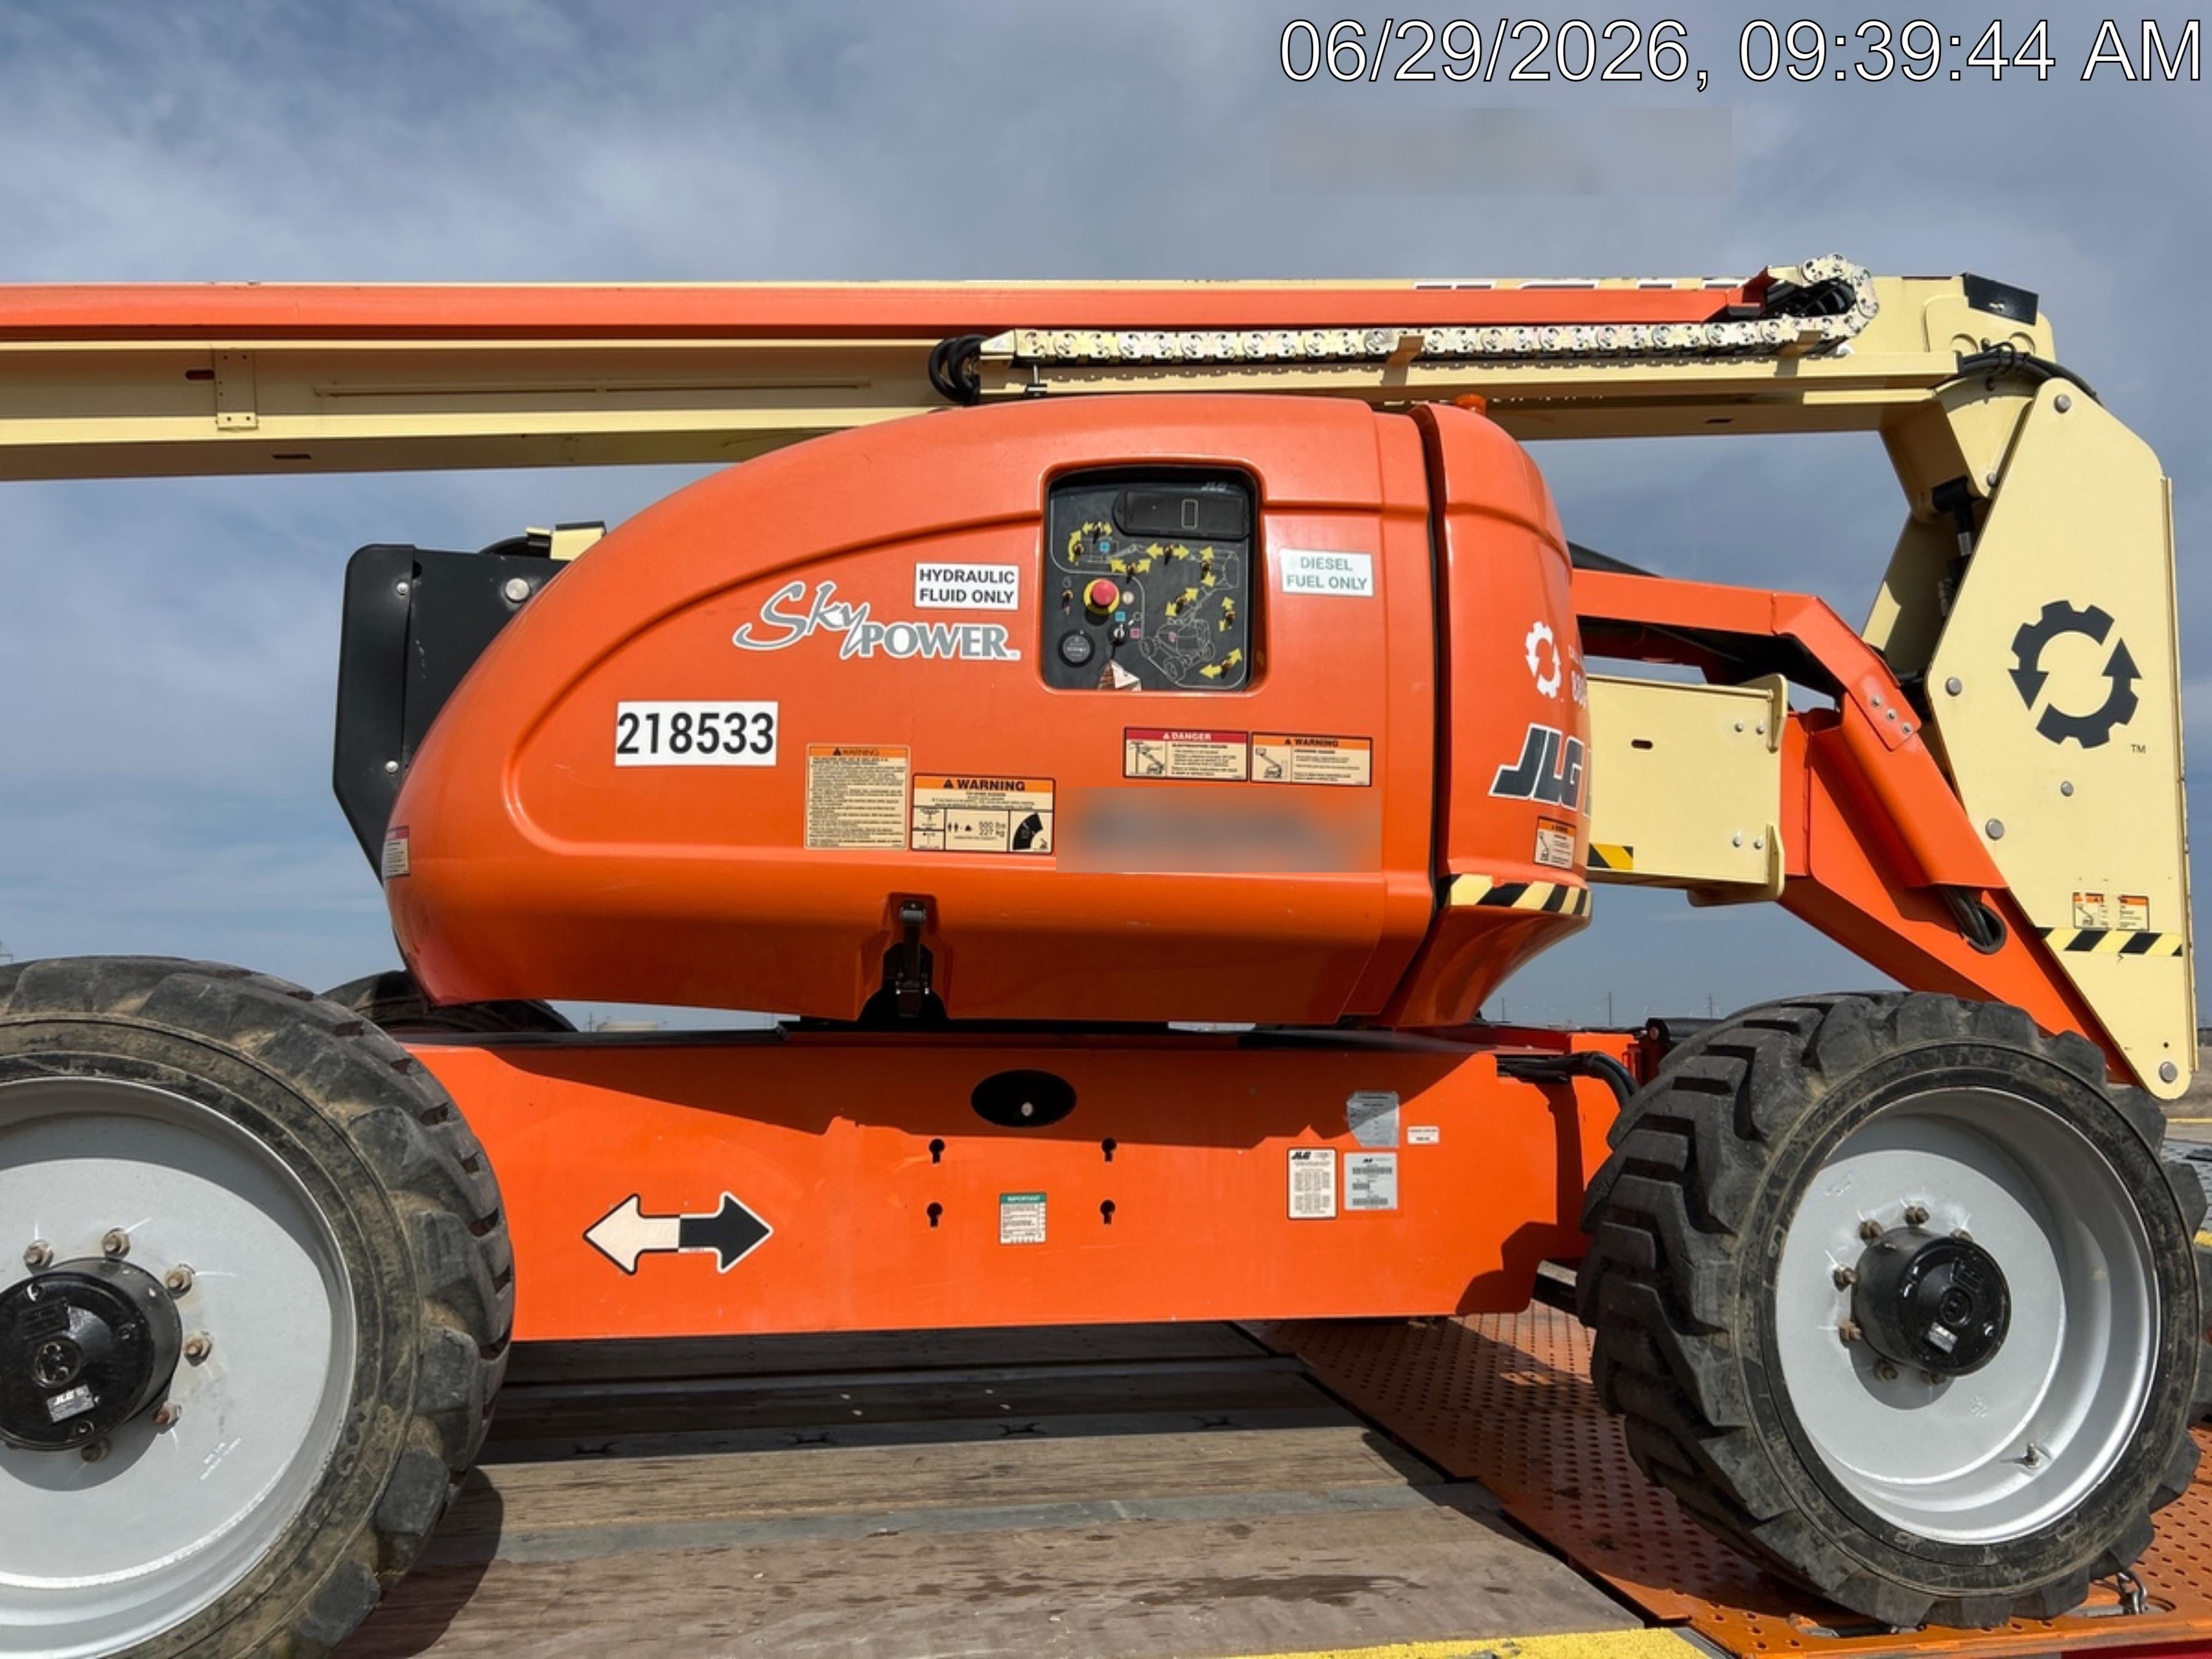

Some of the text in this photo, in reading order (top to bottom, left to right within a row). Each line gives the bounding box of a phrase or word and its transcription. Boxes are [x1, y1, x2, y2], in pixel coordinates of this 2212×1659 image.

[1300, 556, 1353, 571] DIESEL
[919, 569, 1015, 584] HYDRAULIC
[1287, 574, 1367, 590] FUEL ONLY
[919, 588, 1014, 603] FLUID ONLY
[616, 712, 774, 755] 218533
[1171, 732, 1212, 741] DANGER
[1294, 739, 1339, 747] WARNING
[2130, 743, 2146, 754] TM
[1488, 723, 1585, 812] JLG
[957, 779, 1026, 791] WARNING
